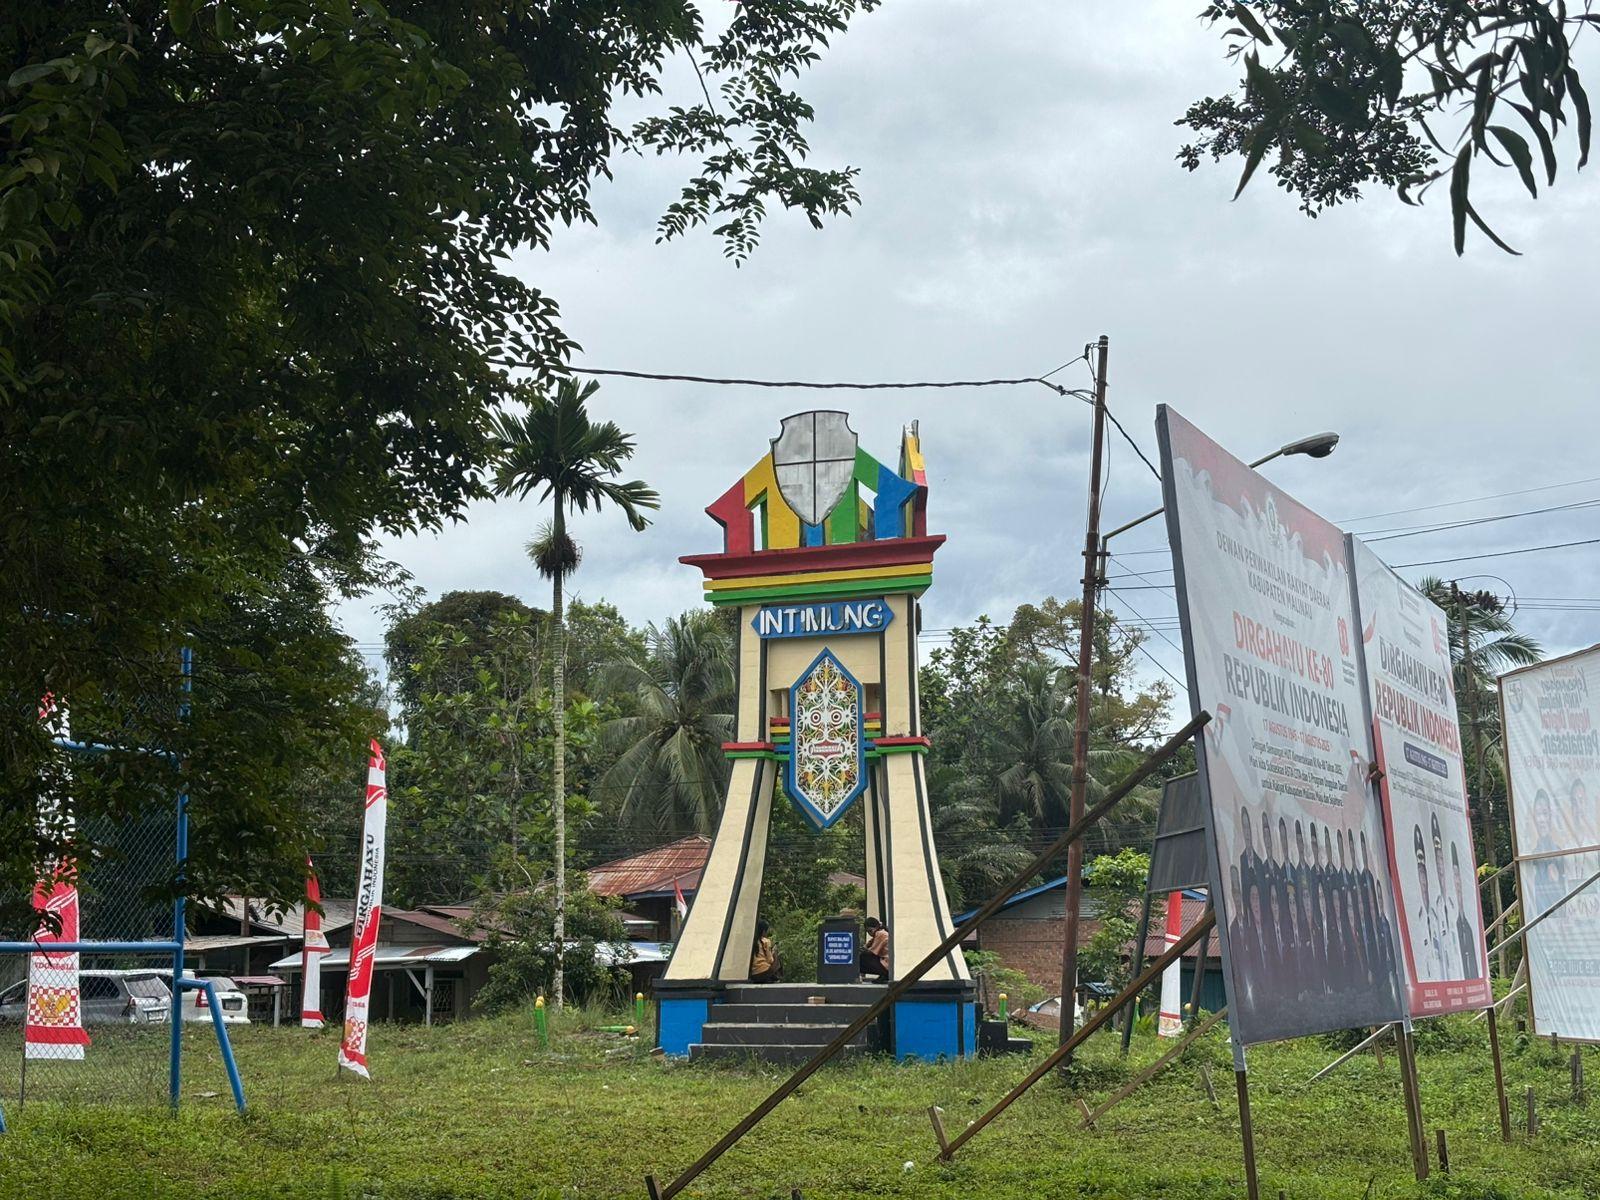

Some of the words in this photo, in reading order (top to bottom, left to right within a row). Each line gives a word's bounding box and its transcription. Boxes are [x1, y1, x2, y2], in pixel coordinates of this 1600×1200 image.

[1216, 530, 1244, 562] DEWAN
[1244, 547, 1286, 586] PERWAKILAN
[1287, 572, 1308, 598] RAKYAT
[1309, 585, 1331, 611] DAERAH
[1247, 570, 1285, 606] KABUPATEN
[1232, 610, 1305, 677] DIRGAHAYU
[1305, 646, 1335, 690] KE-80
[1223, 652, 1289, 717] REPUBLIK
[1289, 682, 1350, 738] INDONESIA
[1374, 678, 1421, 735] REPUBLIK
[356, 834, 375, 936] DIRGAHAYU
